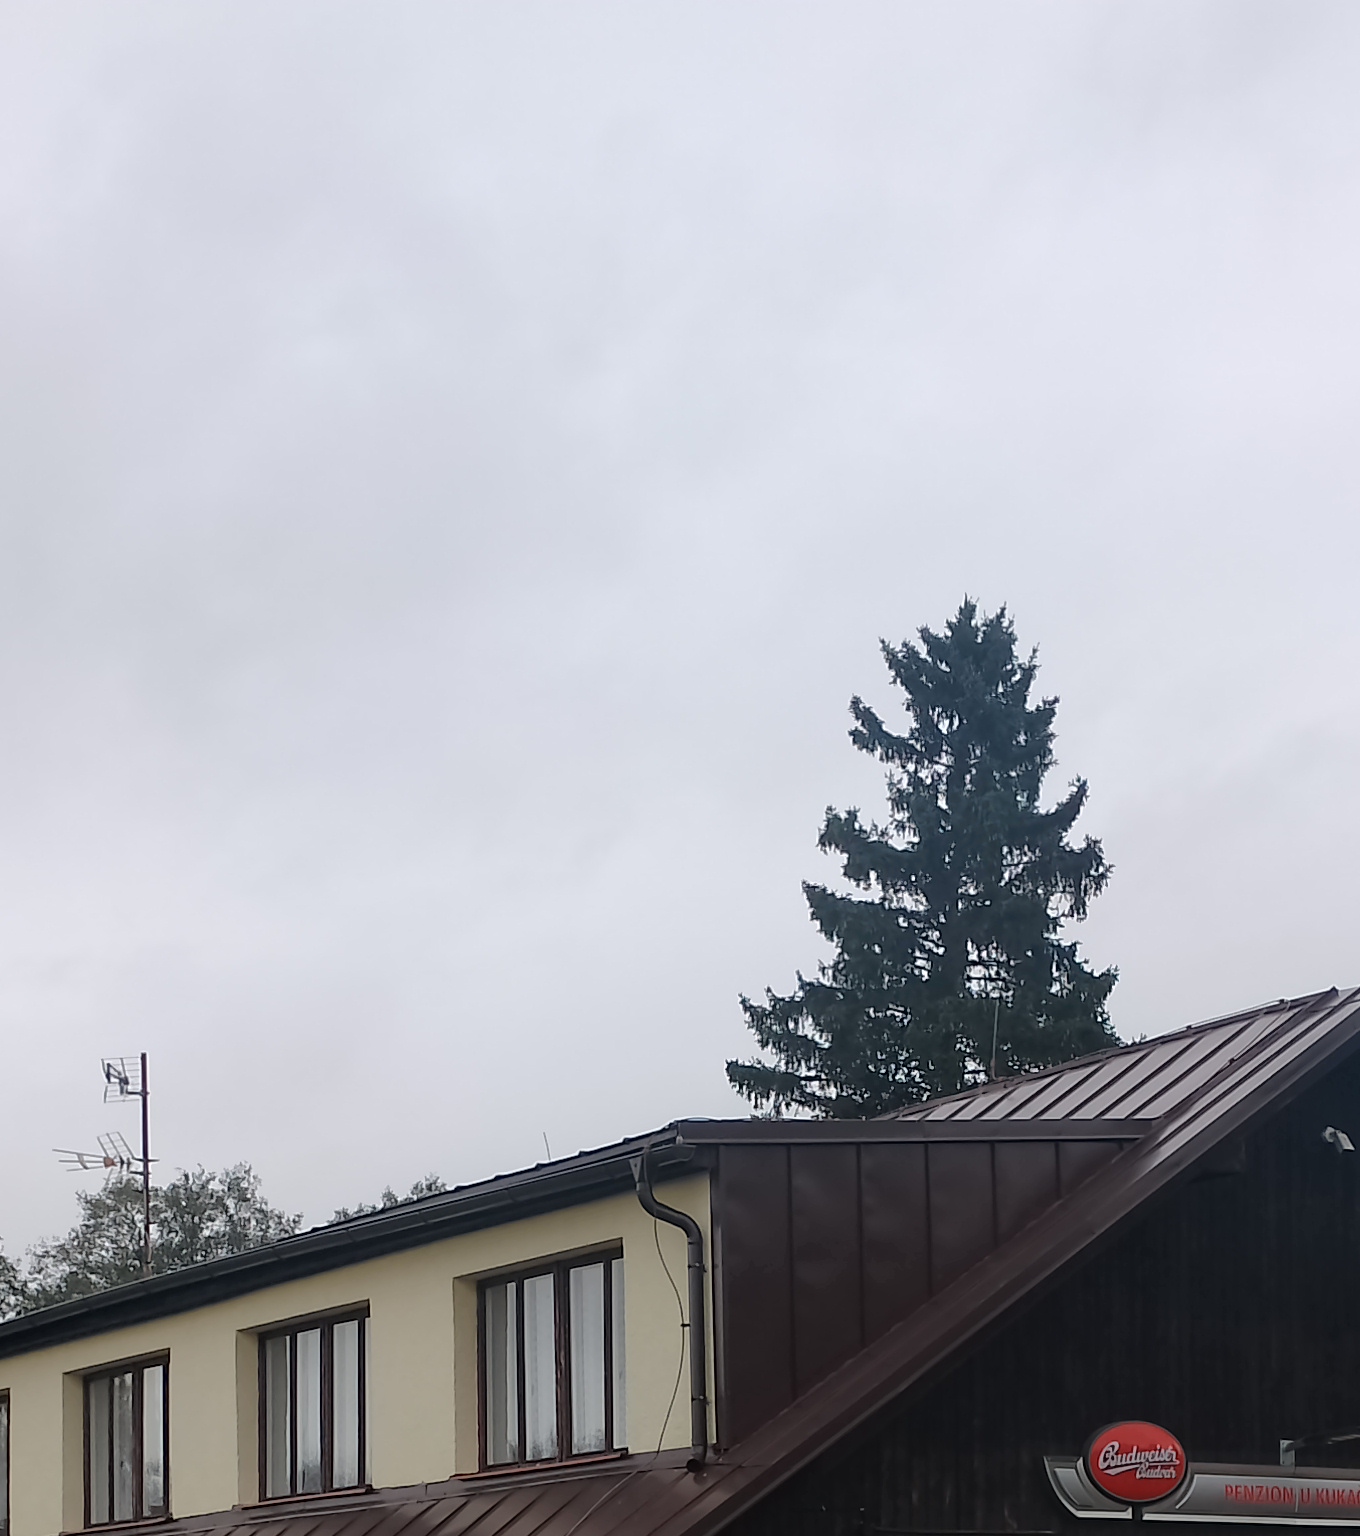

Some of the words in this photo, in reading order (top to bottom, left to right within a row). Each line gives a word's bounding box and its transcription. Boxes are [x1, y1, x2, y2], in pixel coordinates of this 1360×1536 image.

[1098, 1441, 1180, 1472] Budweiser
[1136, 1462, 1177, 1479] Budvar
[1224, 1484, 1295, 1503] PENZION
[1301, 1487, 1311, 1504] U
